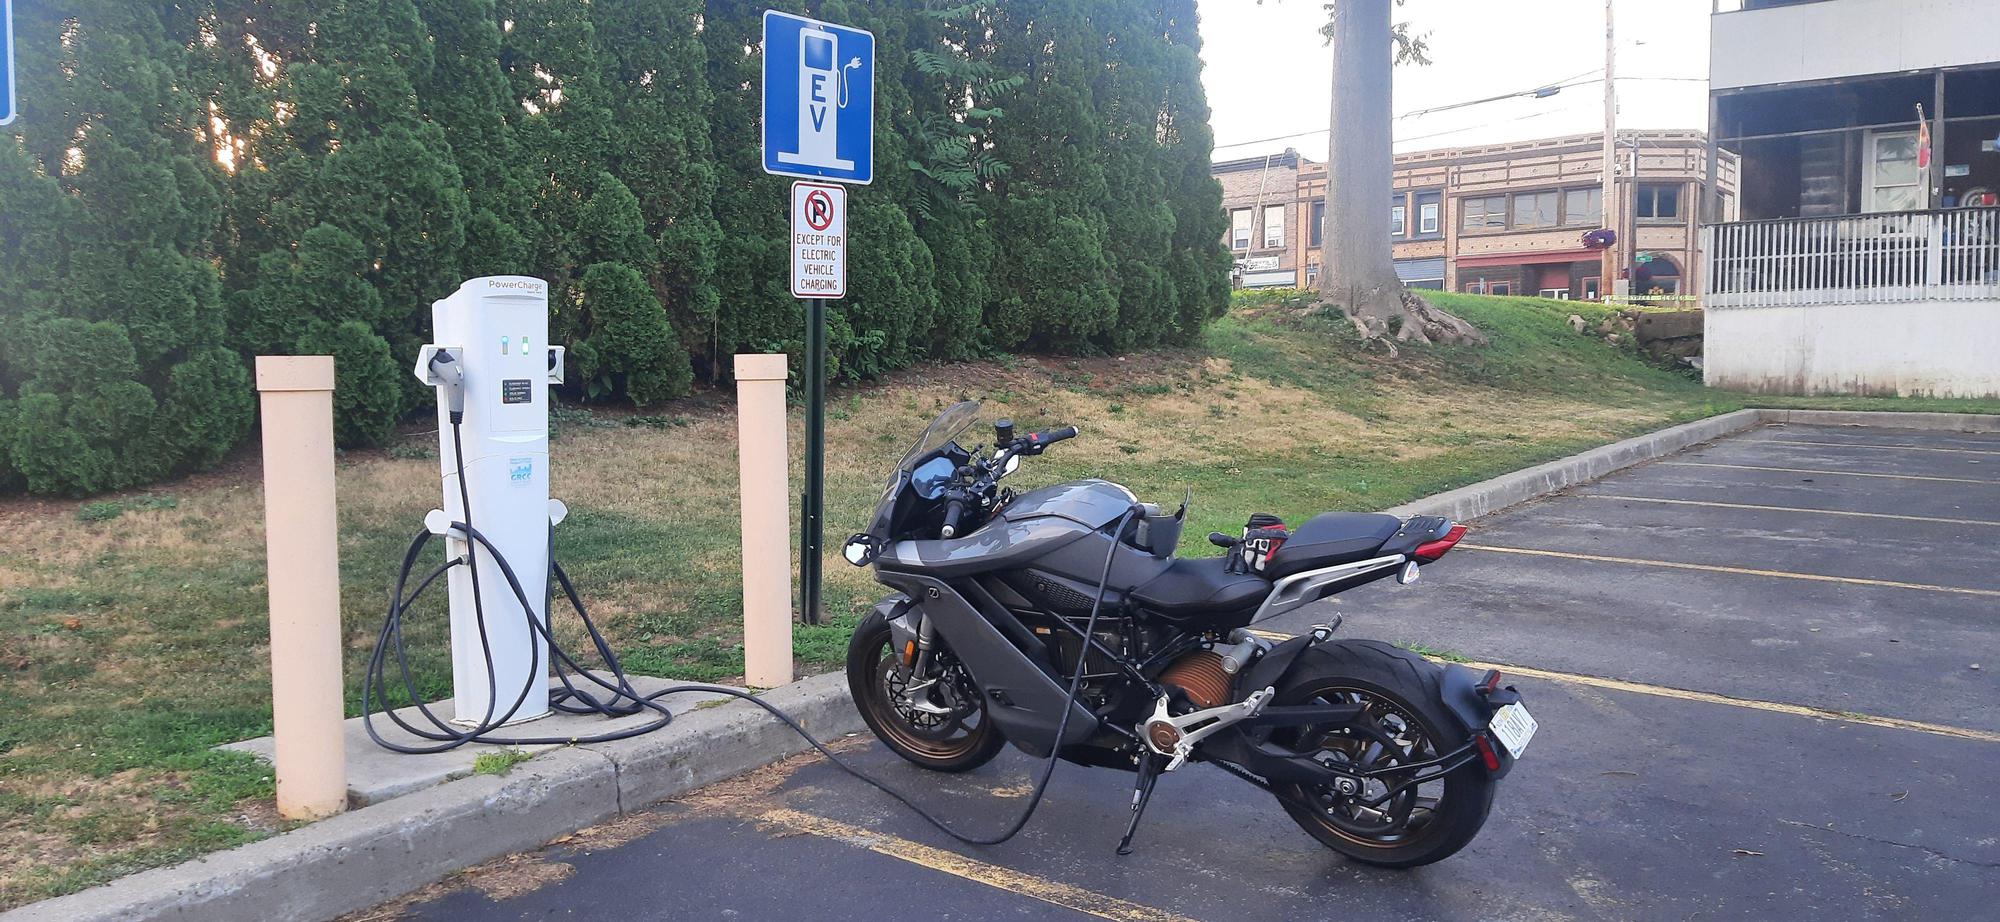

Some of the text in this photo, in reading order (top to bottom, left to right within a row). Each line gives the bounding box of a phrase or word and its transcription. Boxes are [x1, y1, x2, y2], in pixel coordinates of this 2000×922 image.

[810, 74, 826, 133] EV
[796, 233, 842, 247] EXCEPT FOR
[801, 249, 836, 261] ELECTRIC
[803, 263, 834, 276] VEHICLE
[488, 280, 543, 291] PowerCharge
[800, 278, 838, 290] CHARGING
